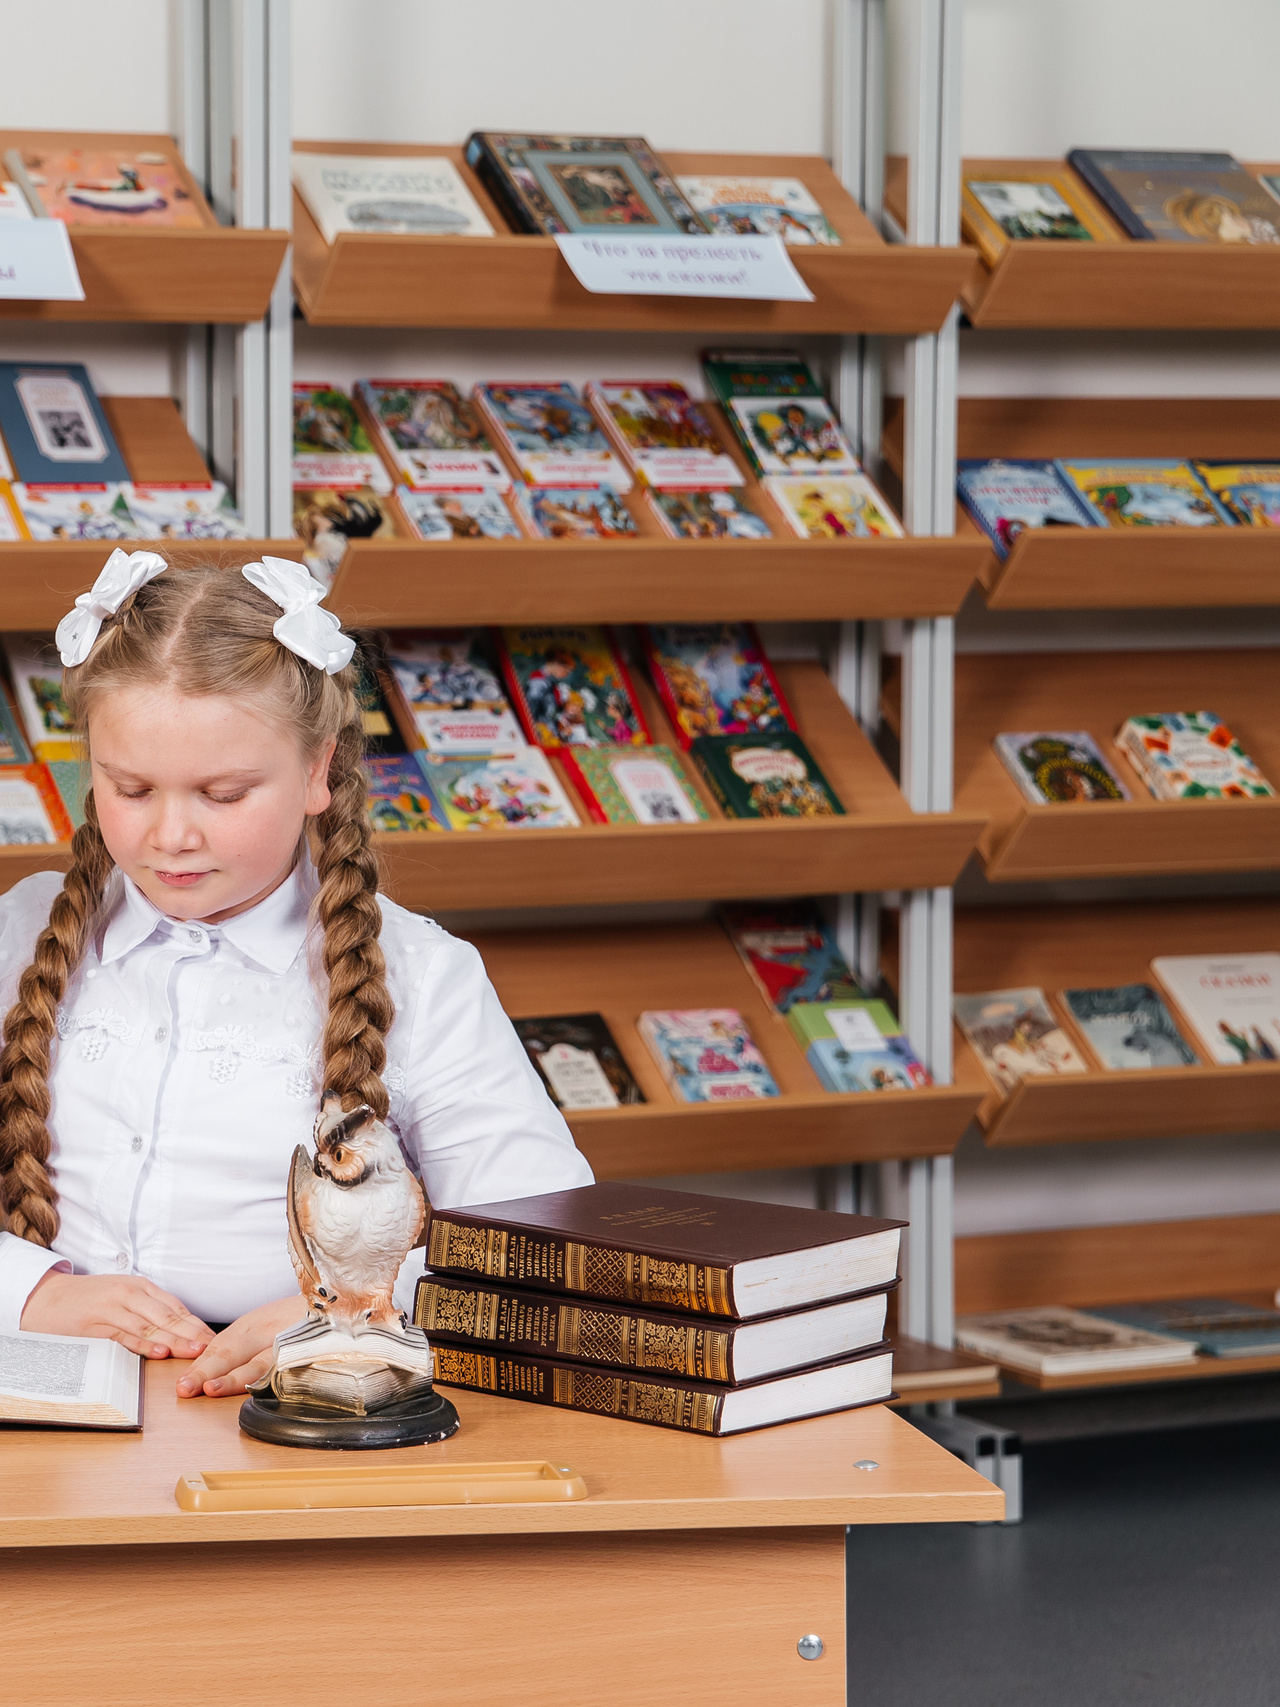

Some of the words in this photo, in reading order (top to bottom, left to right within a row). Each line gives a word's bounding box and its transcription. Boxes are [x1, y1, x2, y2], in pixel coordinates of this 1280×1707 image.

[582, 239, 628, 259] Что
[518, 1236, 526, 1279] ТОЛКОВЫЙ
[509, 1299, 518, 1342] ТОЛКОВЫЙ
[517, 1304, 525, 1340] СЛОВАРЬ
[525, 1306, 533, 1340] ЖИВОГО
[533, 1306, 541, 1341] ВЕЛИКО-
[540, 1306, 549, 1347] РУССКОГО
